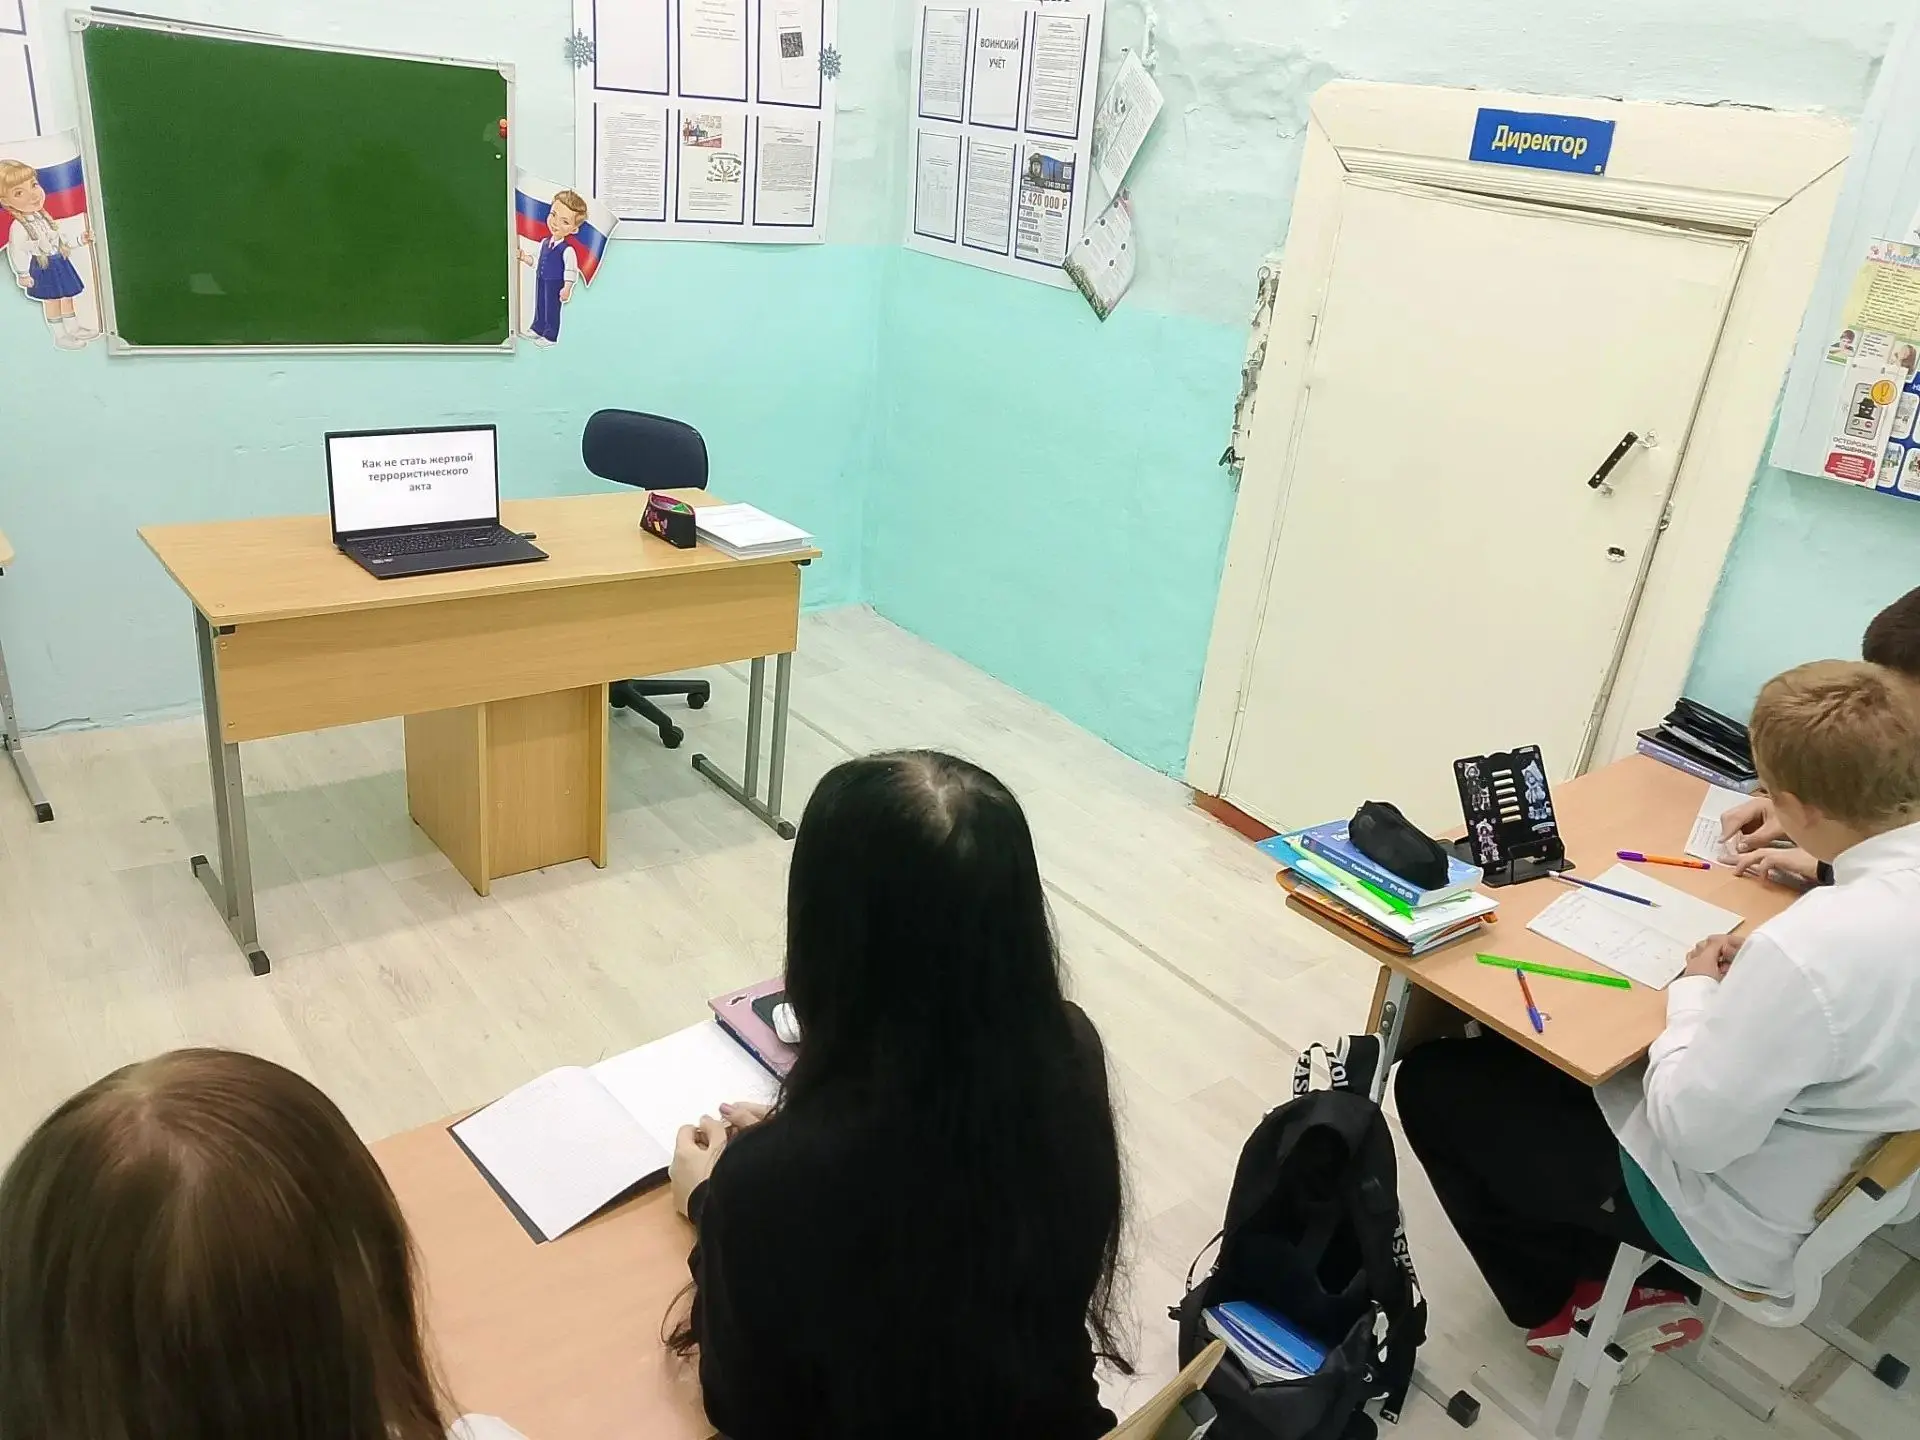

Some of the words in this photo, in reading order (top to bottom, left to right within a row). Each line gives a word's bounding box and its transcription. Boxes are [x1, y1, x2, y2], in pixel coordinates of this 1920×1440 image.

[980, 37, 1019, 50] ВОИНСКИЙ
[1491, 124, 1588, 160] Директор
[1044, 195, 1060, 209] 000
[362, 459, 381, 468] Как
[384, 459, 398, 467] не
[400, 457, 427, 466] стать
[429, 452, 474, 465] жертвой
[368, 467, 469, 482] террористического
[409, 483, 432, 492] акта
